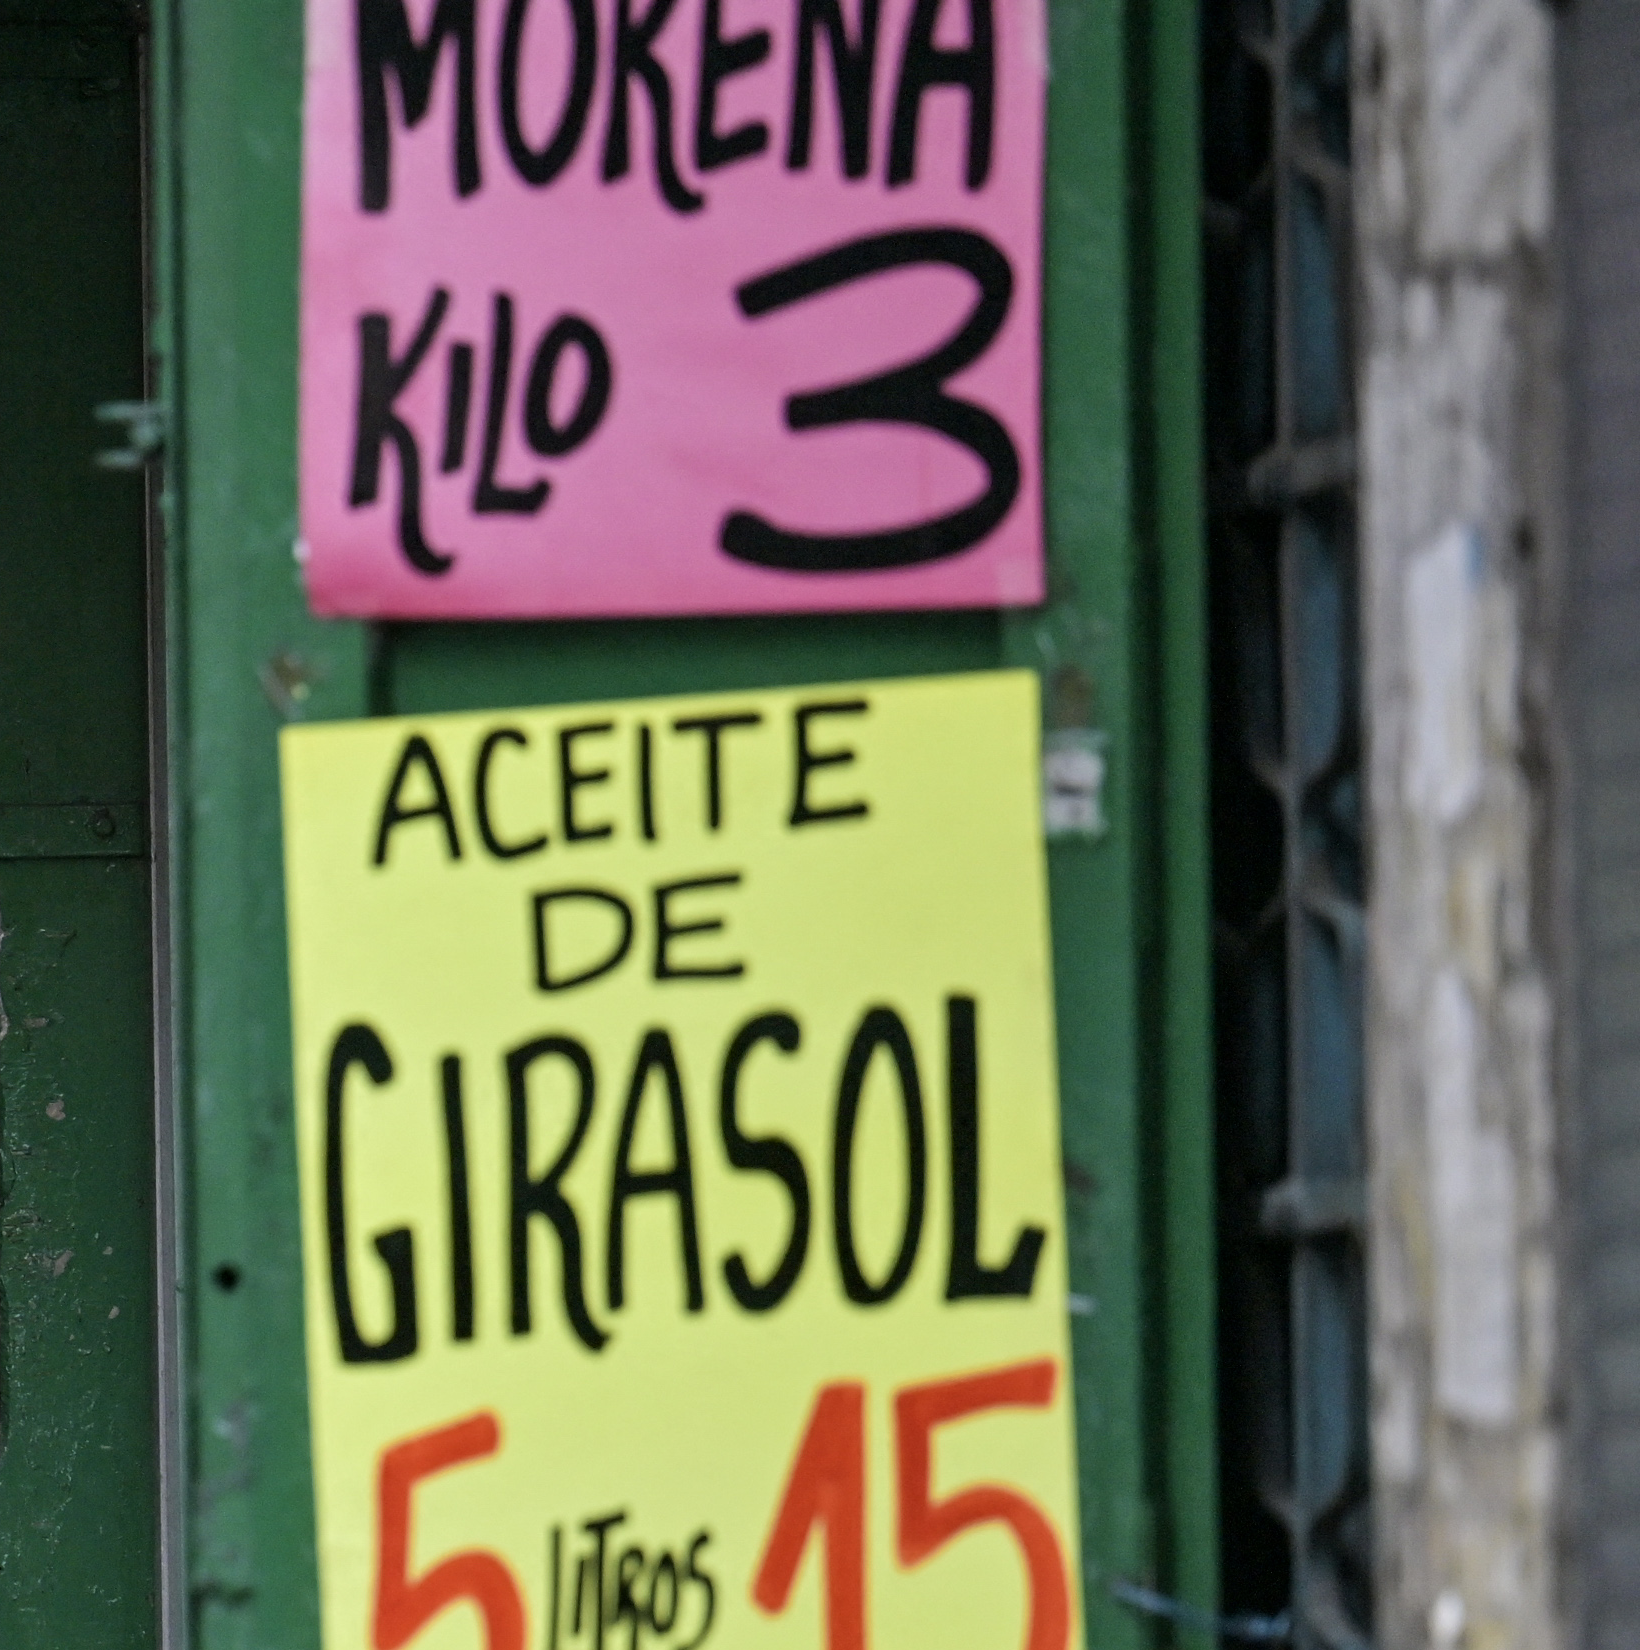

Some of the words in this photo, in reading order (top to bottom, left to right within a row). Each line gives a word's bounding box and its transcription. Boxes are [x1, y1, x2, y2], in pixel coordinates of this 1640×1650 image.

[354, 0, 997, 214] MORENA
[348, 286, 615, 575] KILO
[719, 226, 1021, 574] 3
[371, 700, 869, 868] ACEITE
[534, 873, 745, 992] DE
[326, 993, 1045, 1364] GIRASOL
